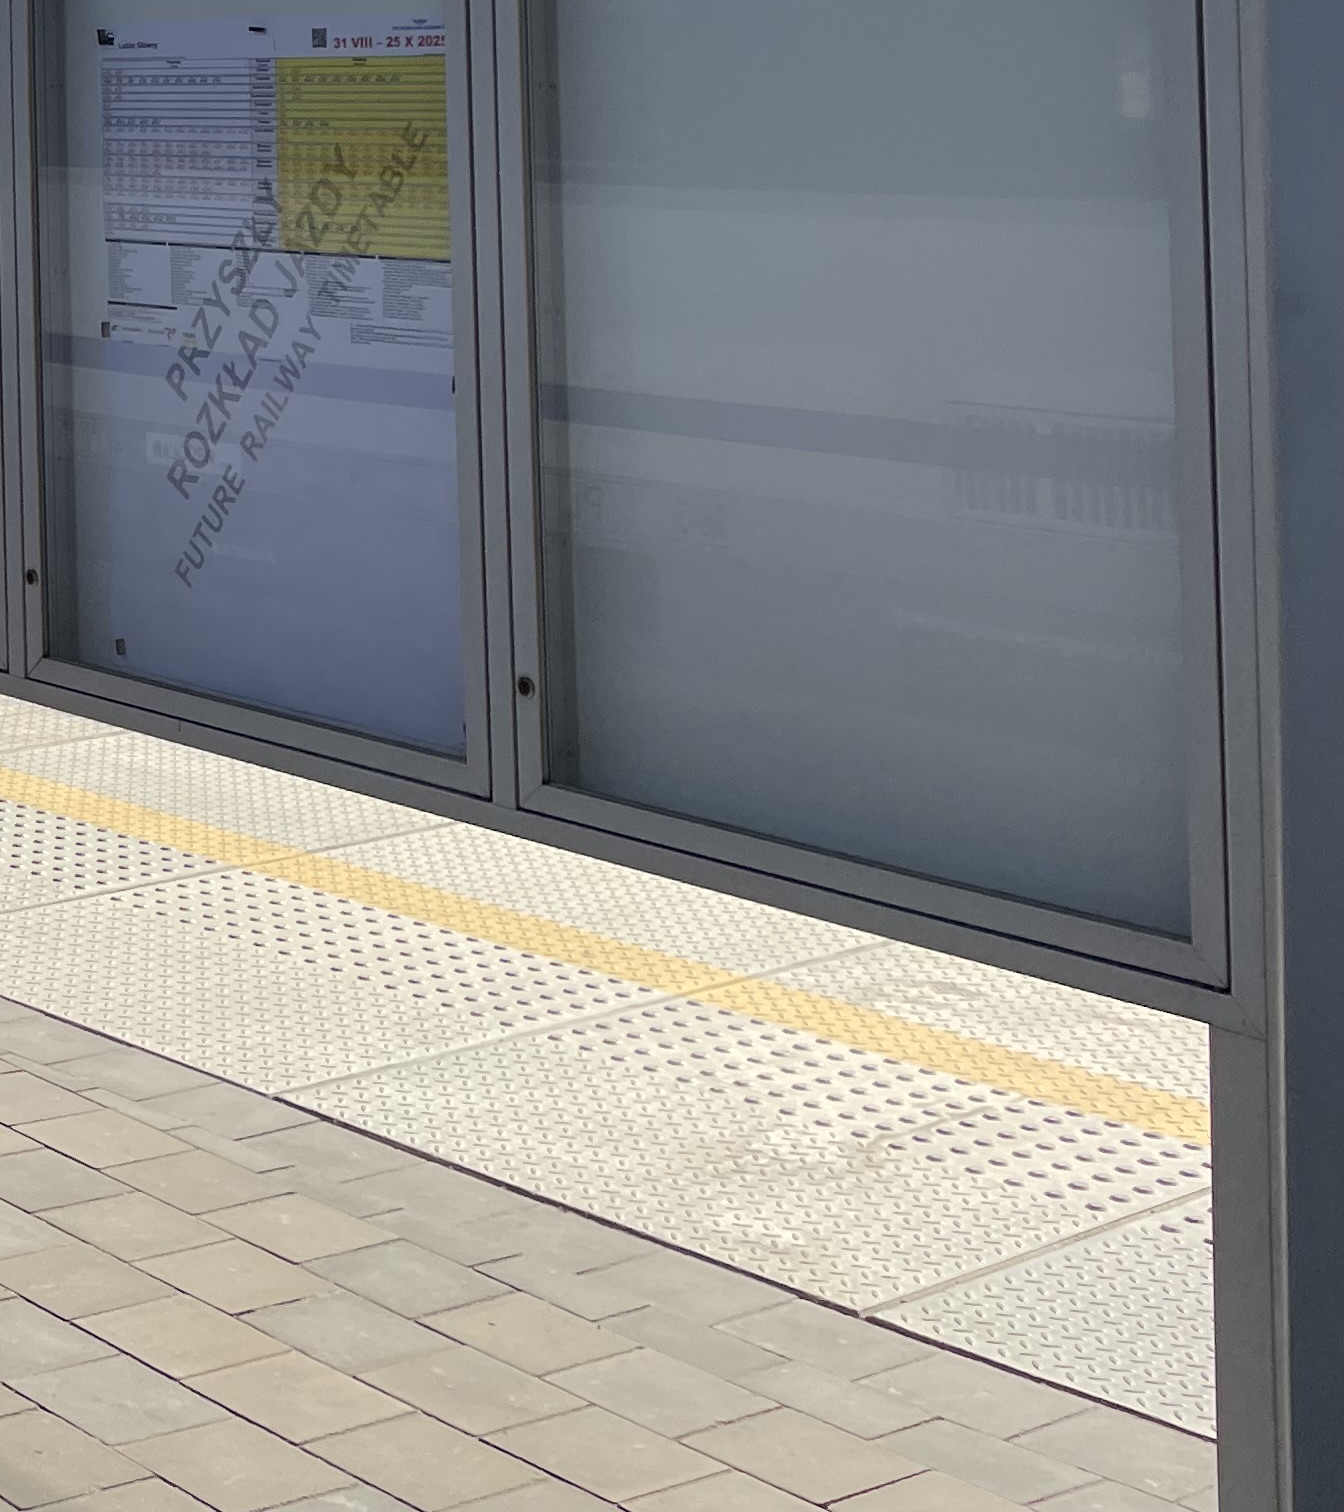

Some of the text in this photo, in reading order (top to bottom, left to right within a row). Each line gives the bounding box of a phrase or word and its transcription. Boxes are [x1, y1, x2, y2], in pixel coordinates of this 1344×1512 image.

[333, 37, 347, 49] 31
[351, 36, 373, 49] VIII
[385, 36, 401, 48] 25
[404, 36, 414, 47] X
[164, 176, 282, 403] PRZYSZŁY
[166, 297, 280, 501] ROZKŁAD
[274, 142, 355, 298] JAZDY
[174, 463, 246, 589] FUTURE
[239, 310, 322, 463] RAILWAY
[317, 120, 430, 305] TIMETABLE
